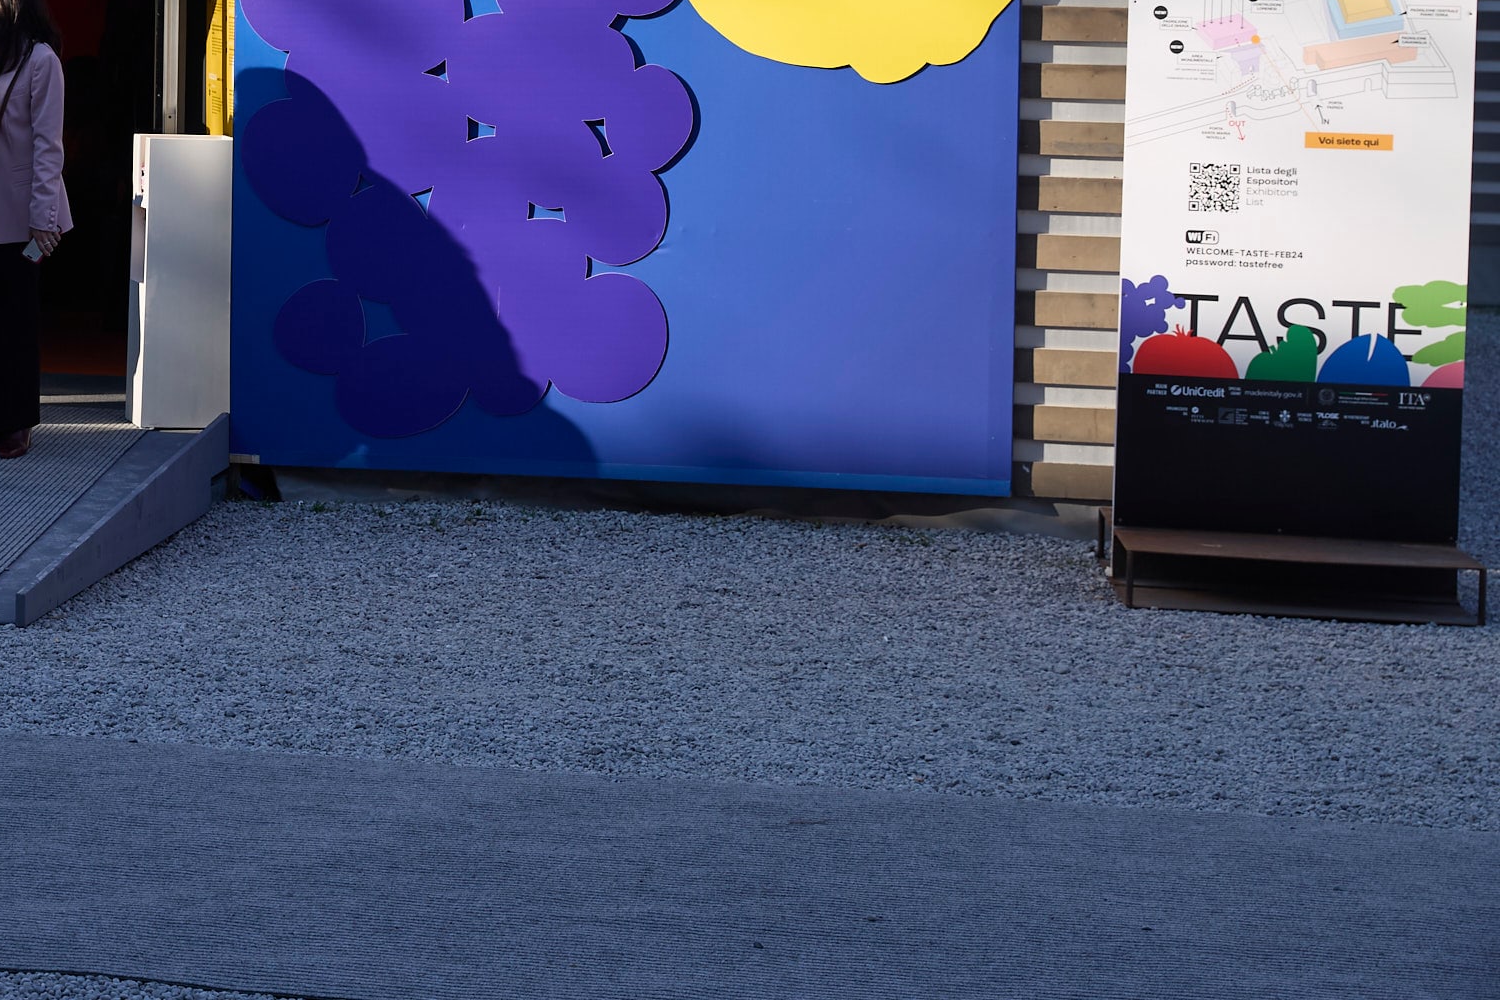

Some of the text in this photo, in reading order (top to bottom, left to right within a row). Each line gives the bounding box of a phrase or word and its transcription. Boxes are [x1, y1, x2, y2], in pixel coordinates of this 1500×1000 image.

[1319, 137, 1379, 148] Voi siete qui
[1274, 168, 1297, 176] degli
[1247, 177, 1298, 186] Espositori
[1246, 187, 1298, 196] Exhibitors
[1246, 198, 1264, 206] List
[1186, 247, 1303, 259] WELCOME-TASTE-FEB24
[1186, 259, 1284, 269] password: tastefree
[1182, 386, 1225, 398] UniCredit
[1399, 393, 1425, 406] ITA
